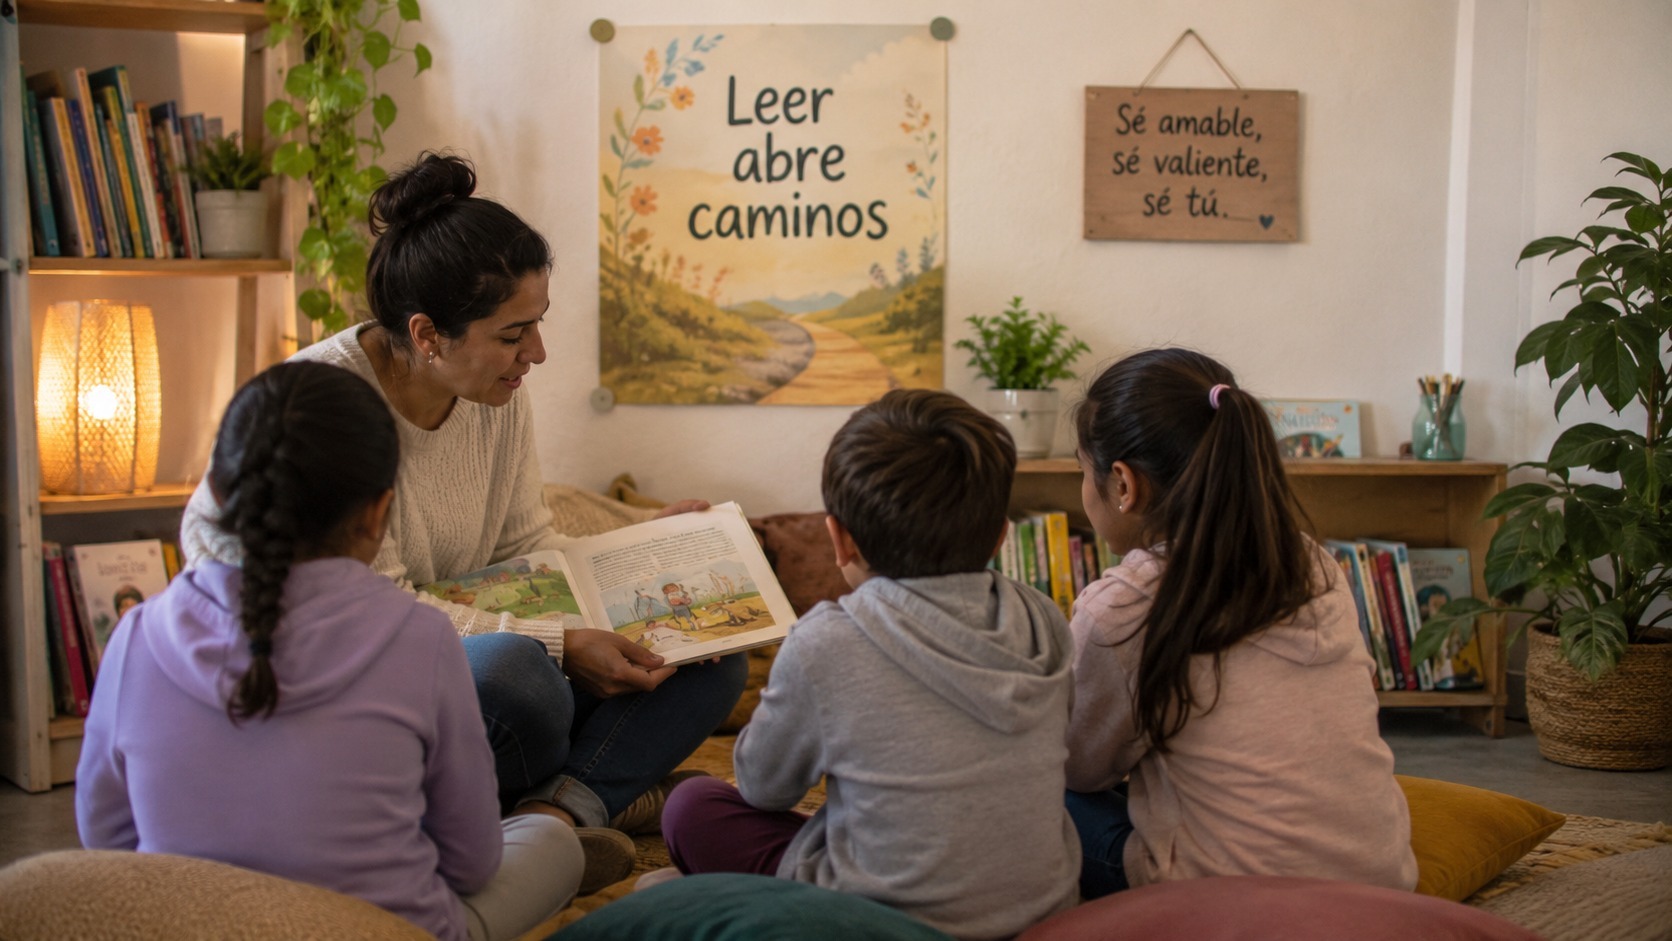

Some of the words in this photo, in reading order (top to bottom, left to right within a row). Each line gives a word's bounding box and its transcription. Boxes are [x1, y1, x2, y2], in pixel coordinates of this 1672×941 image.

[728, 75, 834, 126] Leer
[1116, 103, 1147, 136] Sé
[1159, 106, 1262, 143] amable,
[733, 131, 846, 183] abre
[1112, 146, 1140, 175] sé
[1154, 145, 1268, 183] valiente,
[688, 192, 889, 240] caminos
[1143, 187, 1172, 217] sé
[1186, 186, 1228, 219] tú.
